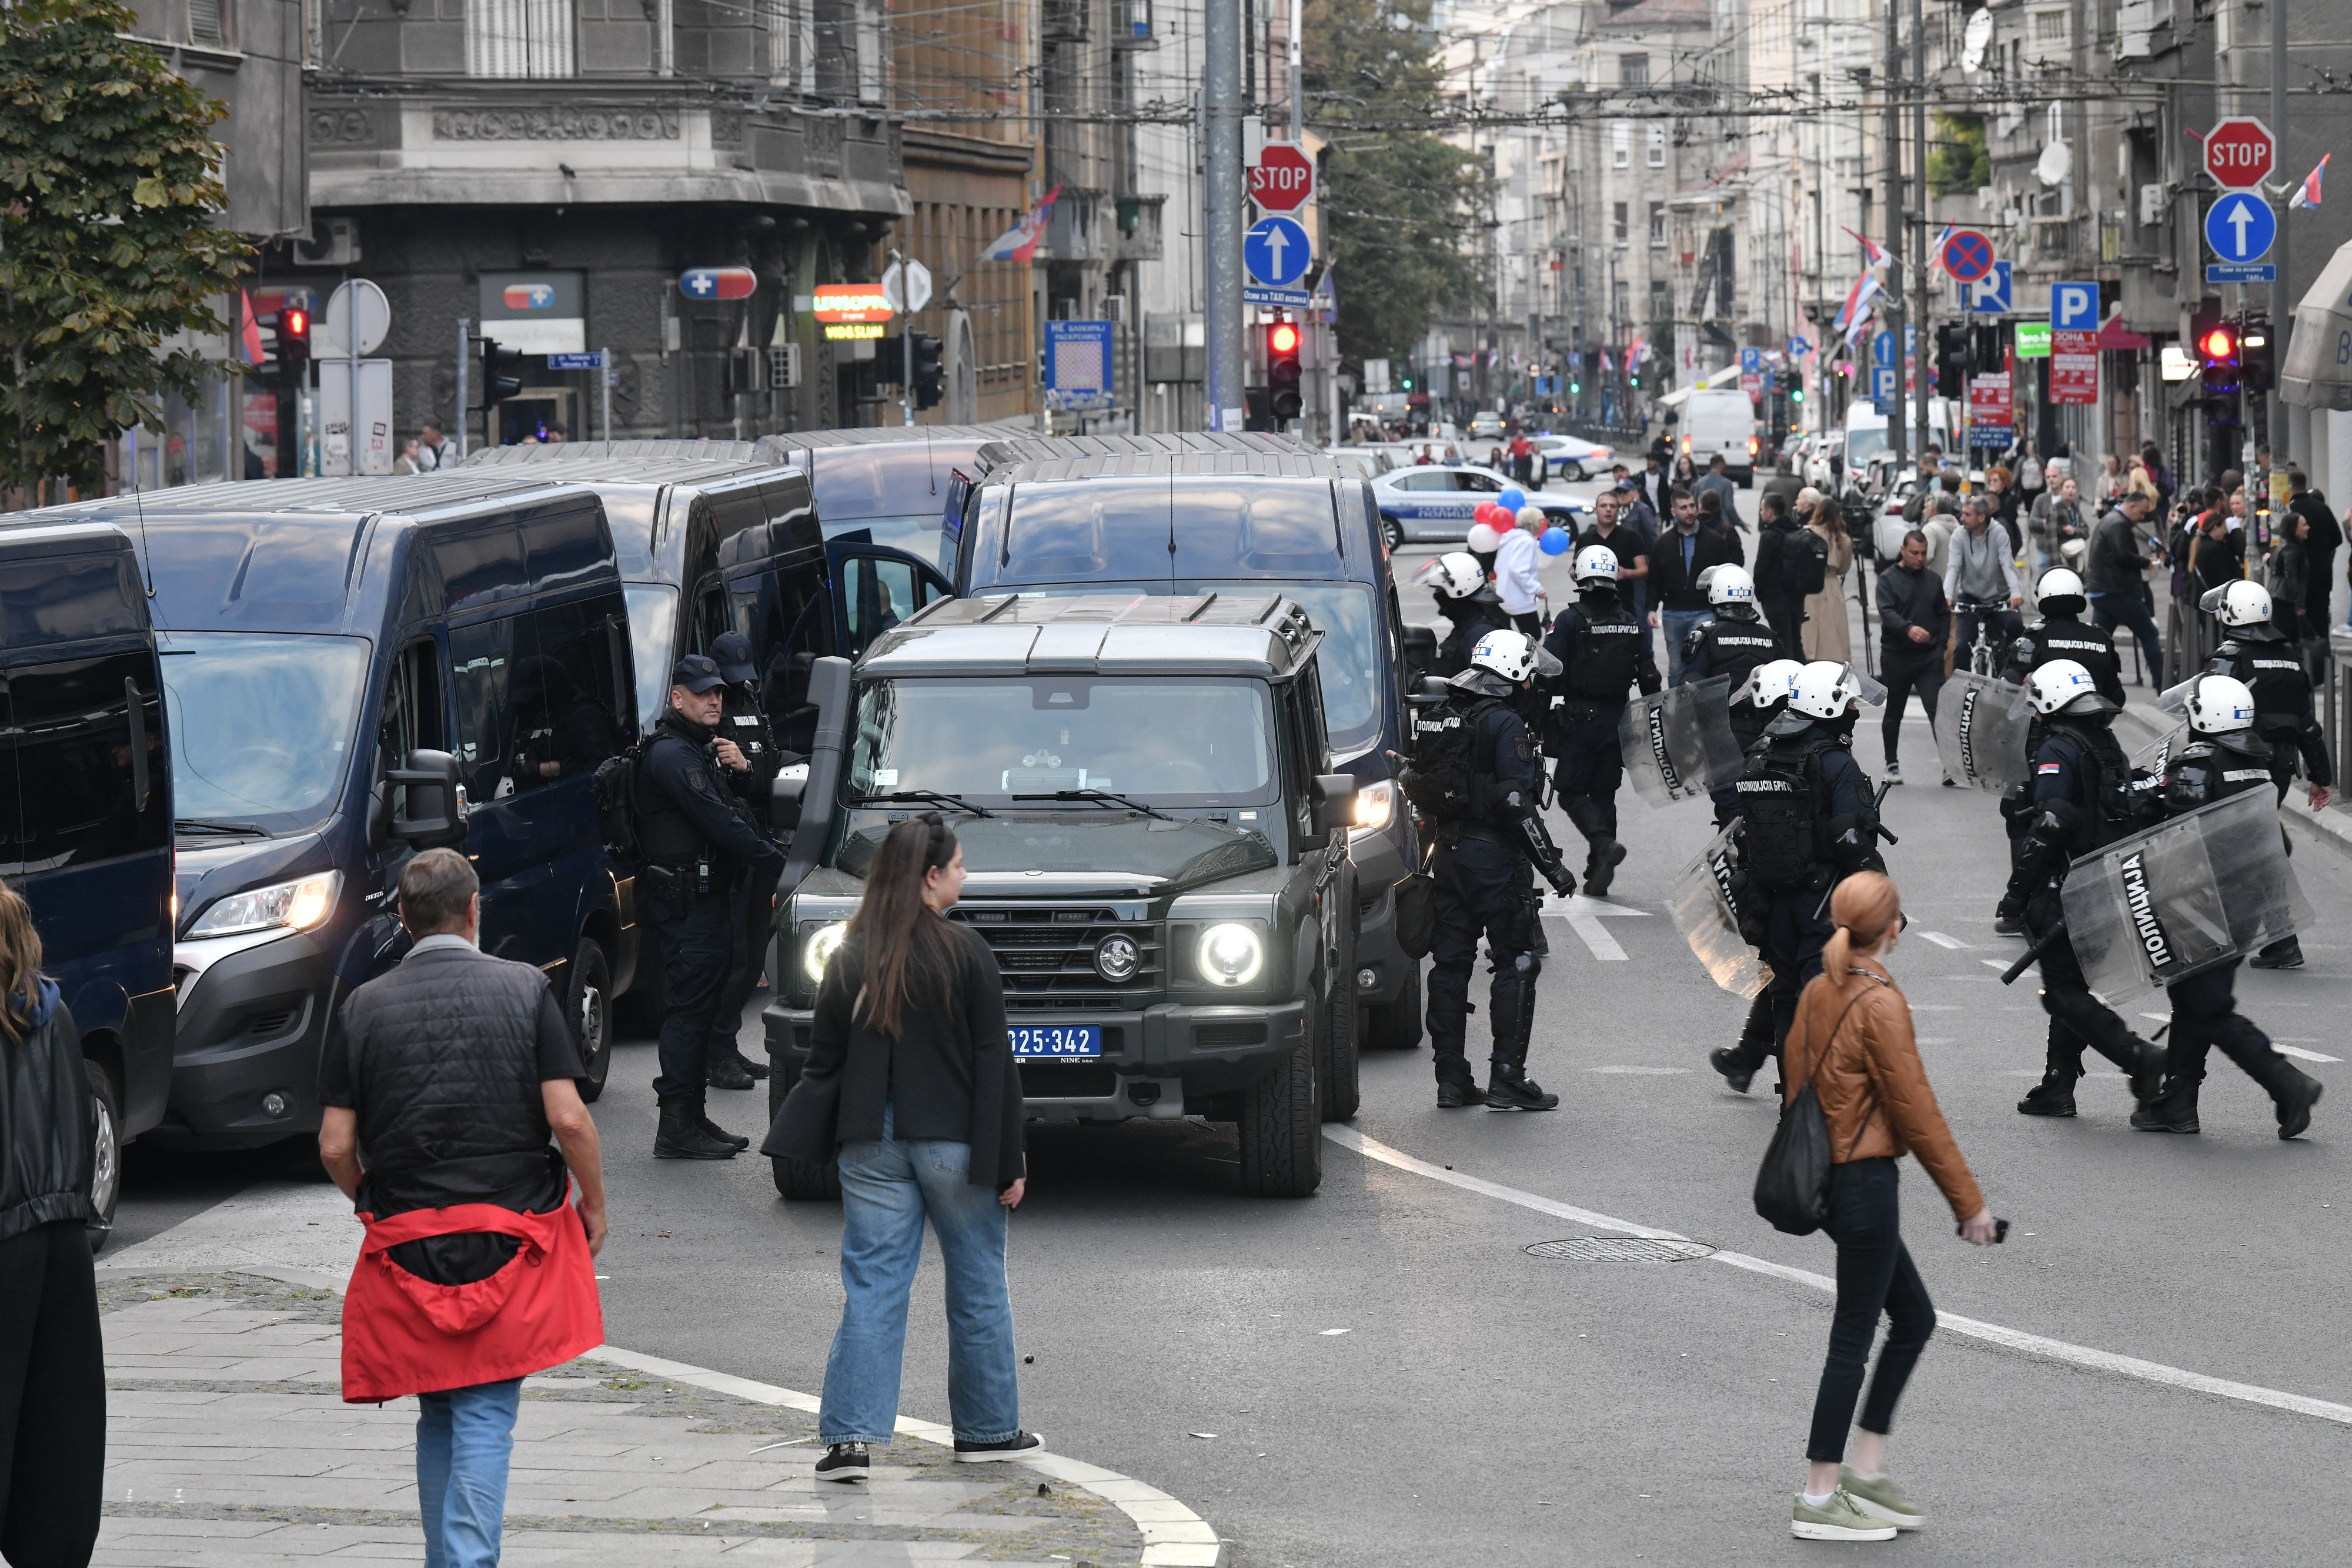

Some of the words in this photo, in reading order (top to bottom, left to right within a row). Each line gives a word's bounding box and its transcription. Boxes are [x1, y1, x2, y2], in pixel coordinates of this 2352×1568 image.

[2213, 142, 2267, 167] STOP
[1253, 166, 1307, 190] STOP
[1269, 292, 1285, 302] TAXI
[2062, 288, 2089, 326] P
[2054, 332, 2084, 342] ЗОНА
[2091, 333, 2096, 342] 1
[1879, 370, 1896, 398] P
[1591, 625, 1618, 634] ПОЛИЦИЈСКА
[1618, 625, 1639, 634] БРИГАДА
[1718, 636, 1752, 646] ПОЛИЦИЈСКА
[1751, 637, 1773, 648] БРИГАДА
[2048, 639, 2084, 650] ПОЛИЦИЈСКА
[2083, 641, 2107, 654] БРИГАДА
[1417, 720, 1444, 733] ПОЛИЦИЈ
[1736, 780, 1773, 793] ПОЛИЦИЈСКА
